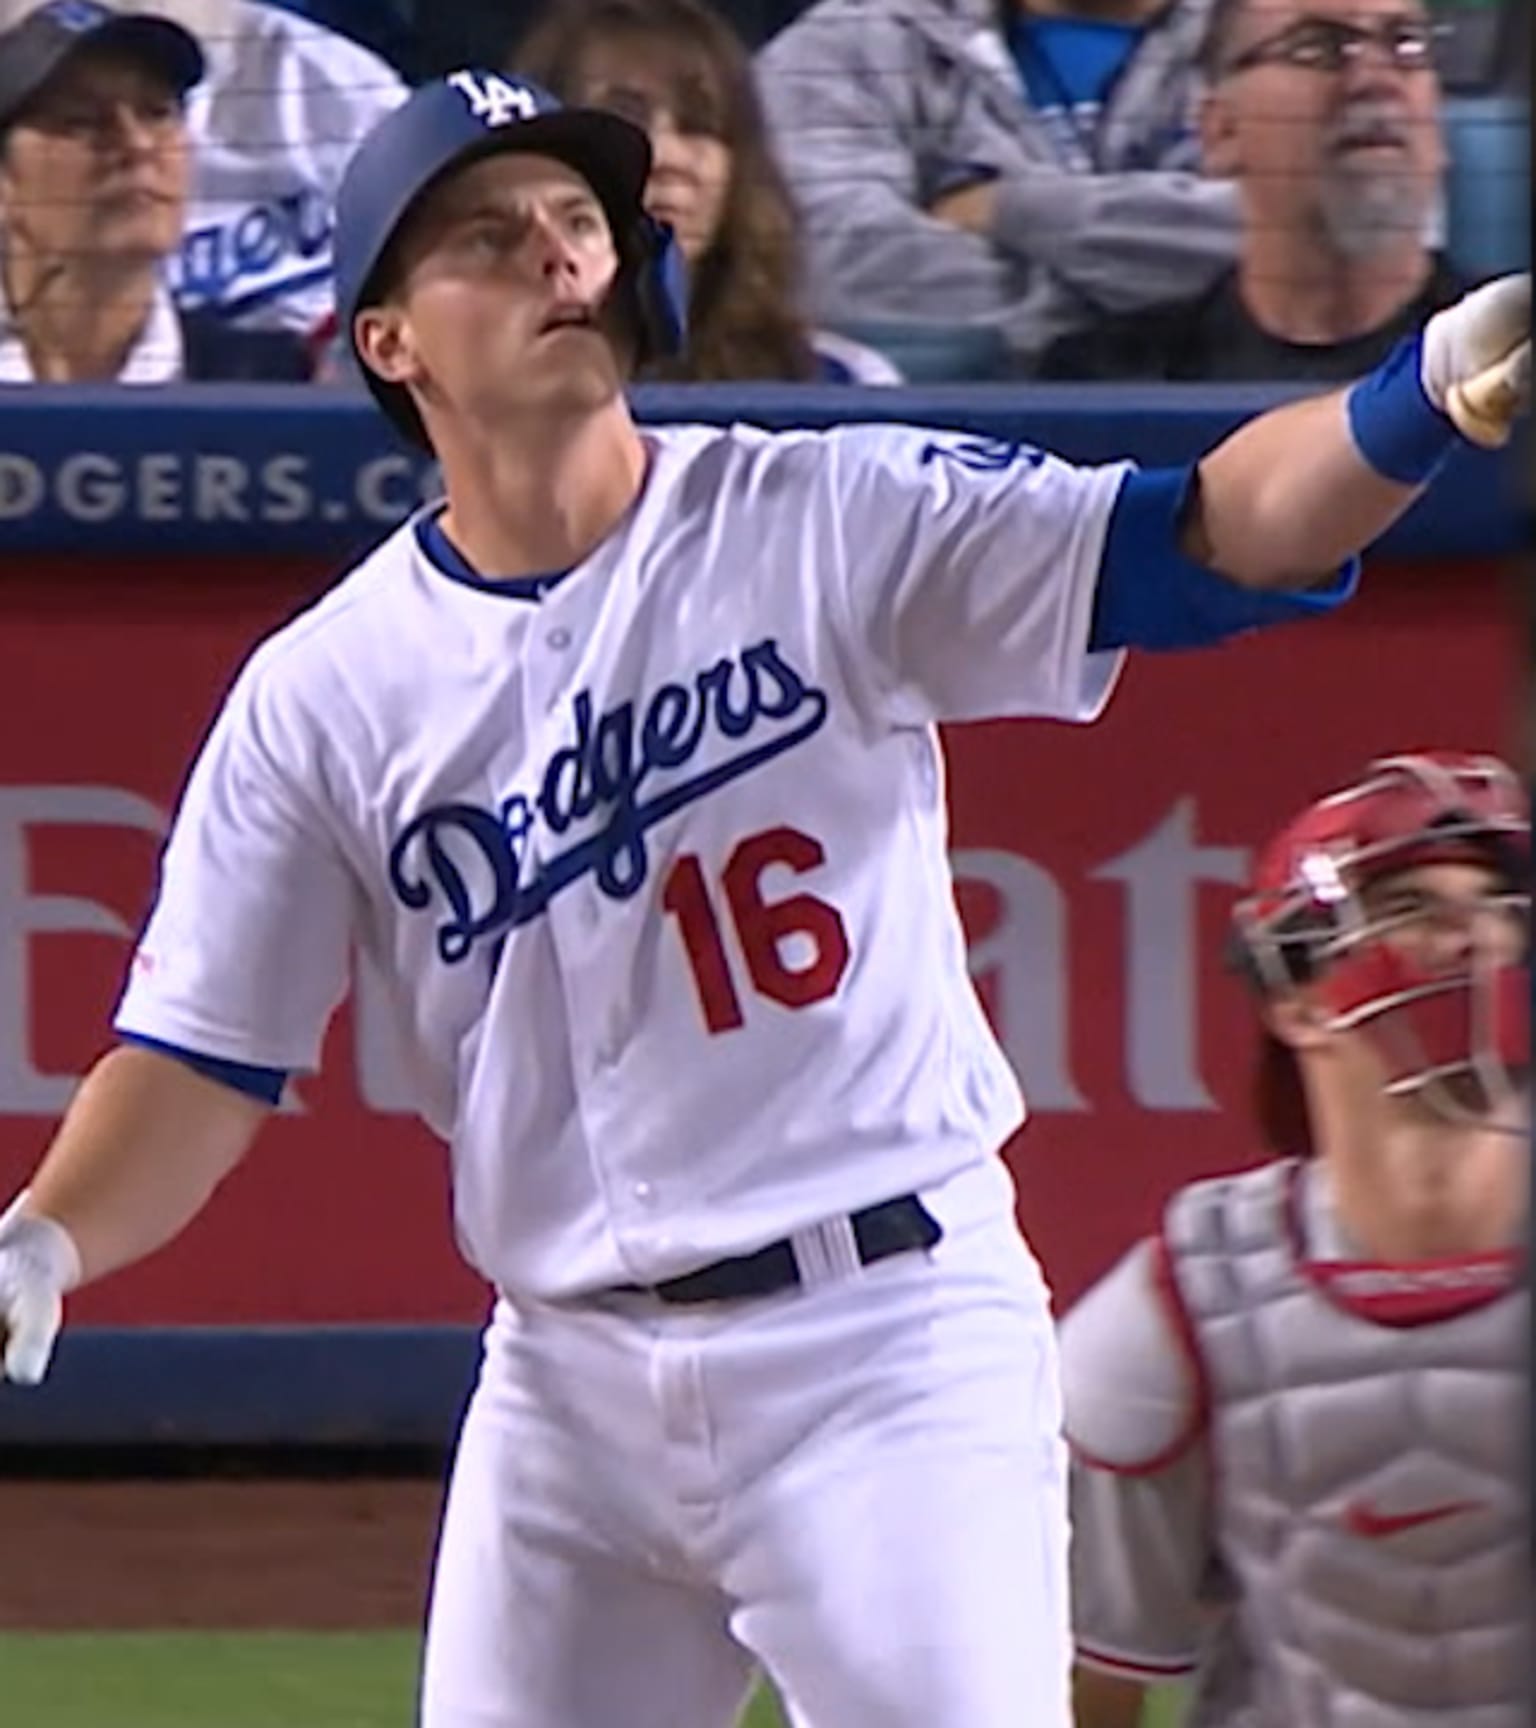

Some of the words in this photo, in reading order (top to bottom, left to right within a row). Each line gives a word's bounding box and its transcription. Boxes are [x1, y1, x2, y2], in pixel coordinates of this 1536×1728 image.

[448, 69, 538, 128] LA
[390, 638, 828, 965] Dodgers
[663, 825, 853, 1036] 16
